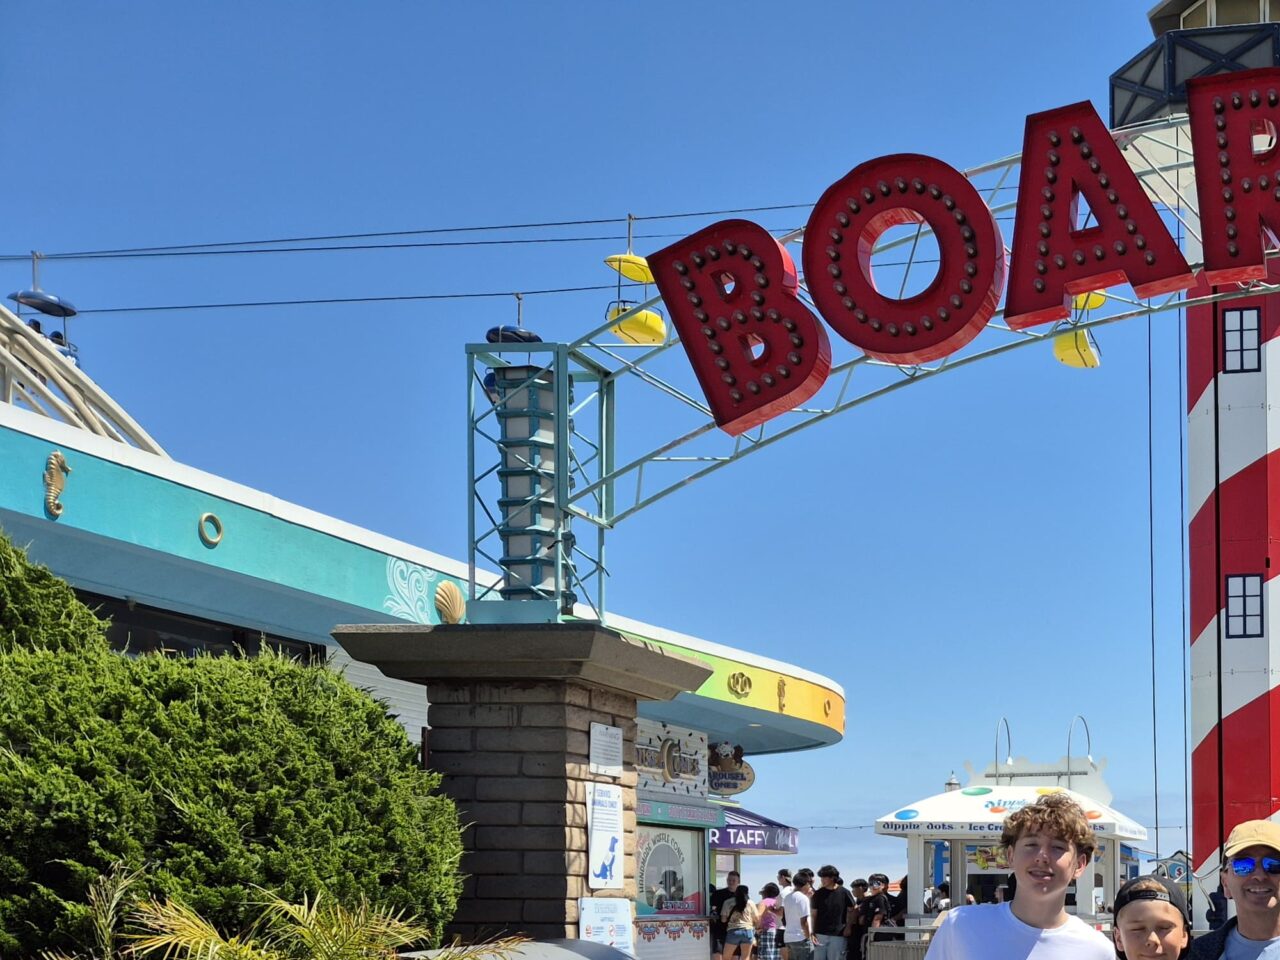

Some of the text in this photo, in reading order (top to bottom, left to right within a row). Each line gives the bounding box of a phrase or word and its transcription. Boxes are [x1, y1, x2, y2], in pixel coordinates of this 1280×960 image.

[968, 823, 985, 831] Ice
[987, 823, 1004, 831] Cre
[727, 829, 770, 846] TAFFY
